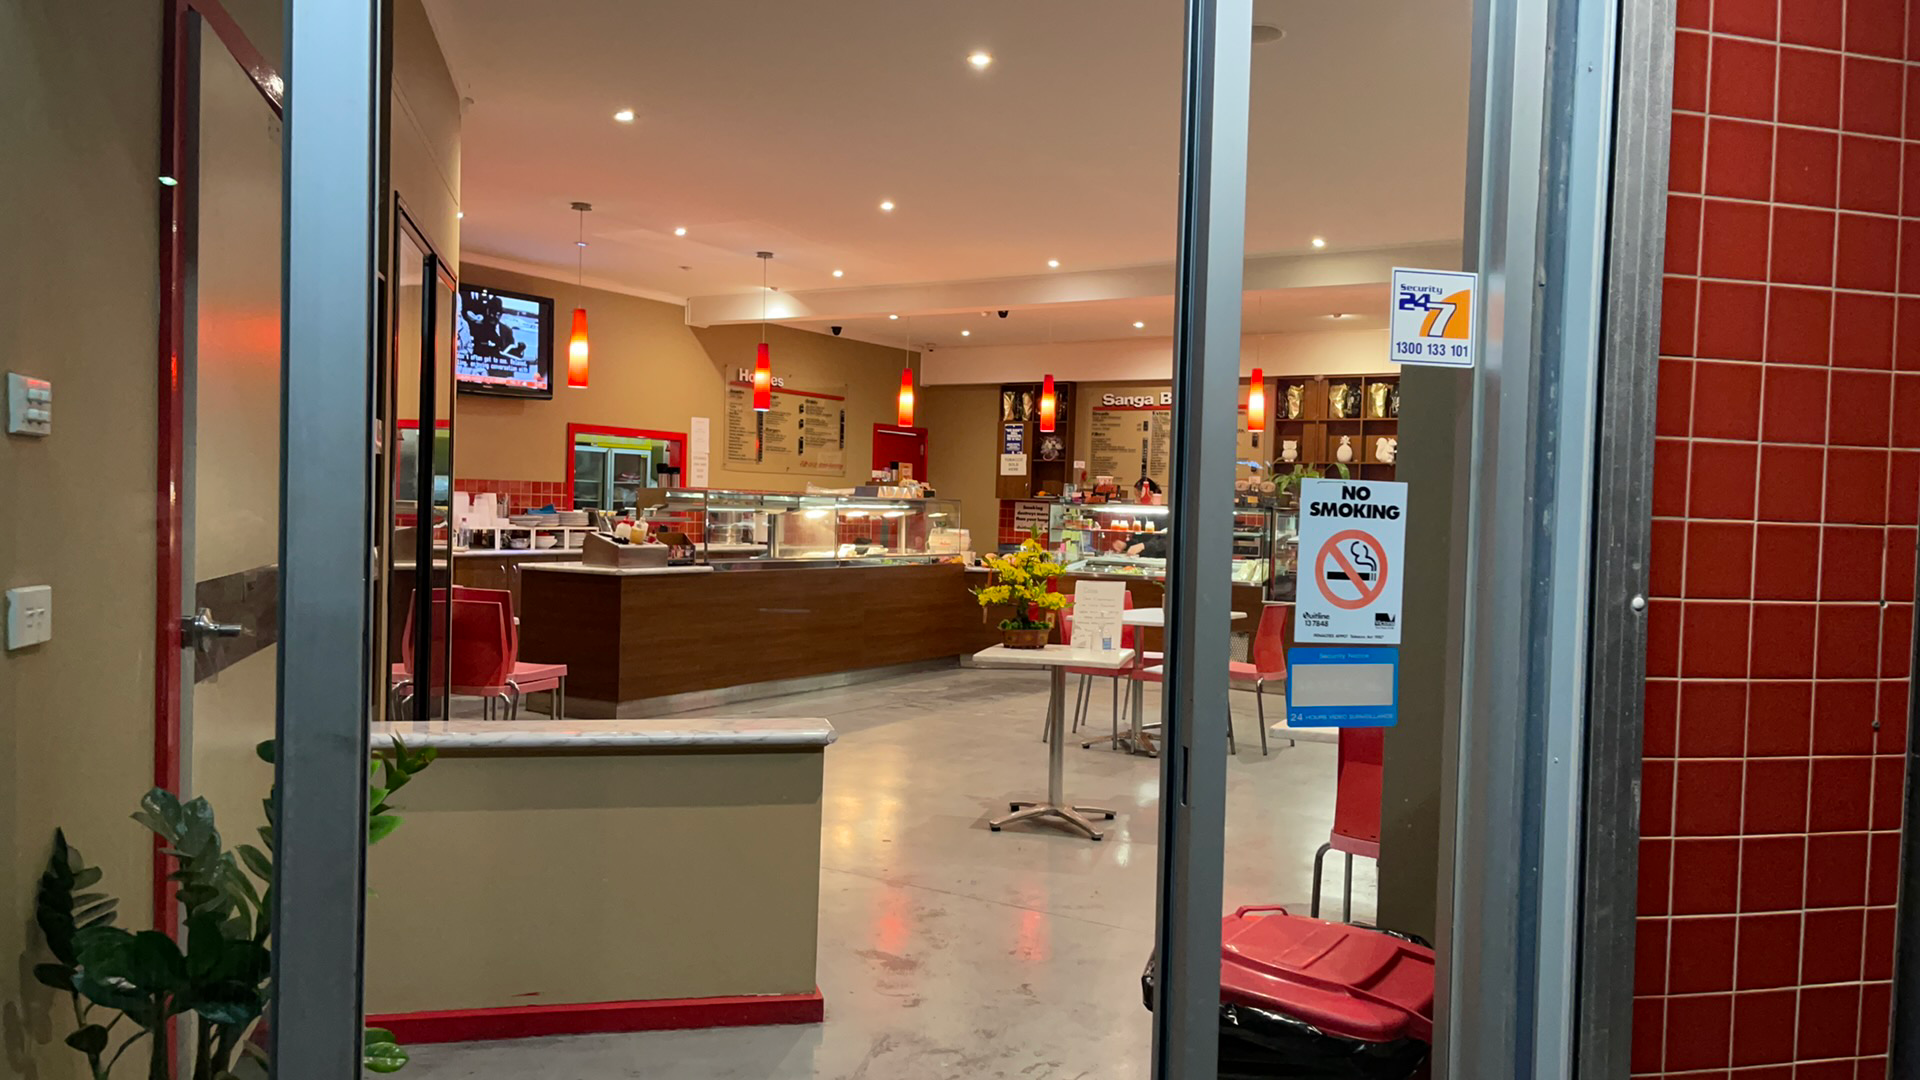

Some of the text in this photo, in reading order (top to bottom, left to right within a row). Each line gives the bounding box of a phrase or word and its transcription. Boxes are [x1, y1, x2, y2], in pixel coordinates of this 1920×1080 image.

[1400, 283, 1443, 295] Security
[1396, 342, 1468, 357] 1300 133 101
[1102, 393, 1154, 407] Sanga
[1342, 486, 1371, 501] NO
[1310, 502, 1400, 520] SMOKING
[1303, 611, 1330, 620] Quitline
[1290, 713, 1303, 722] 24
